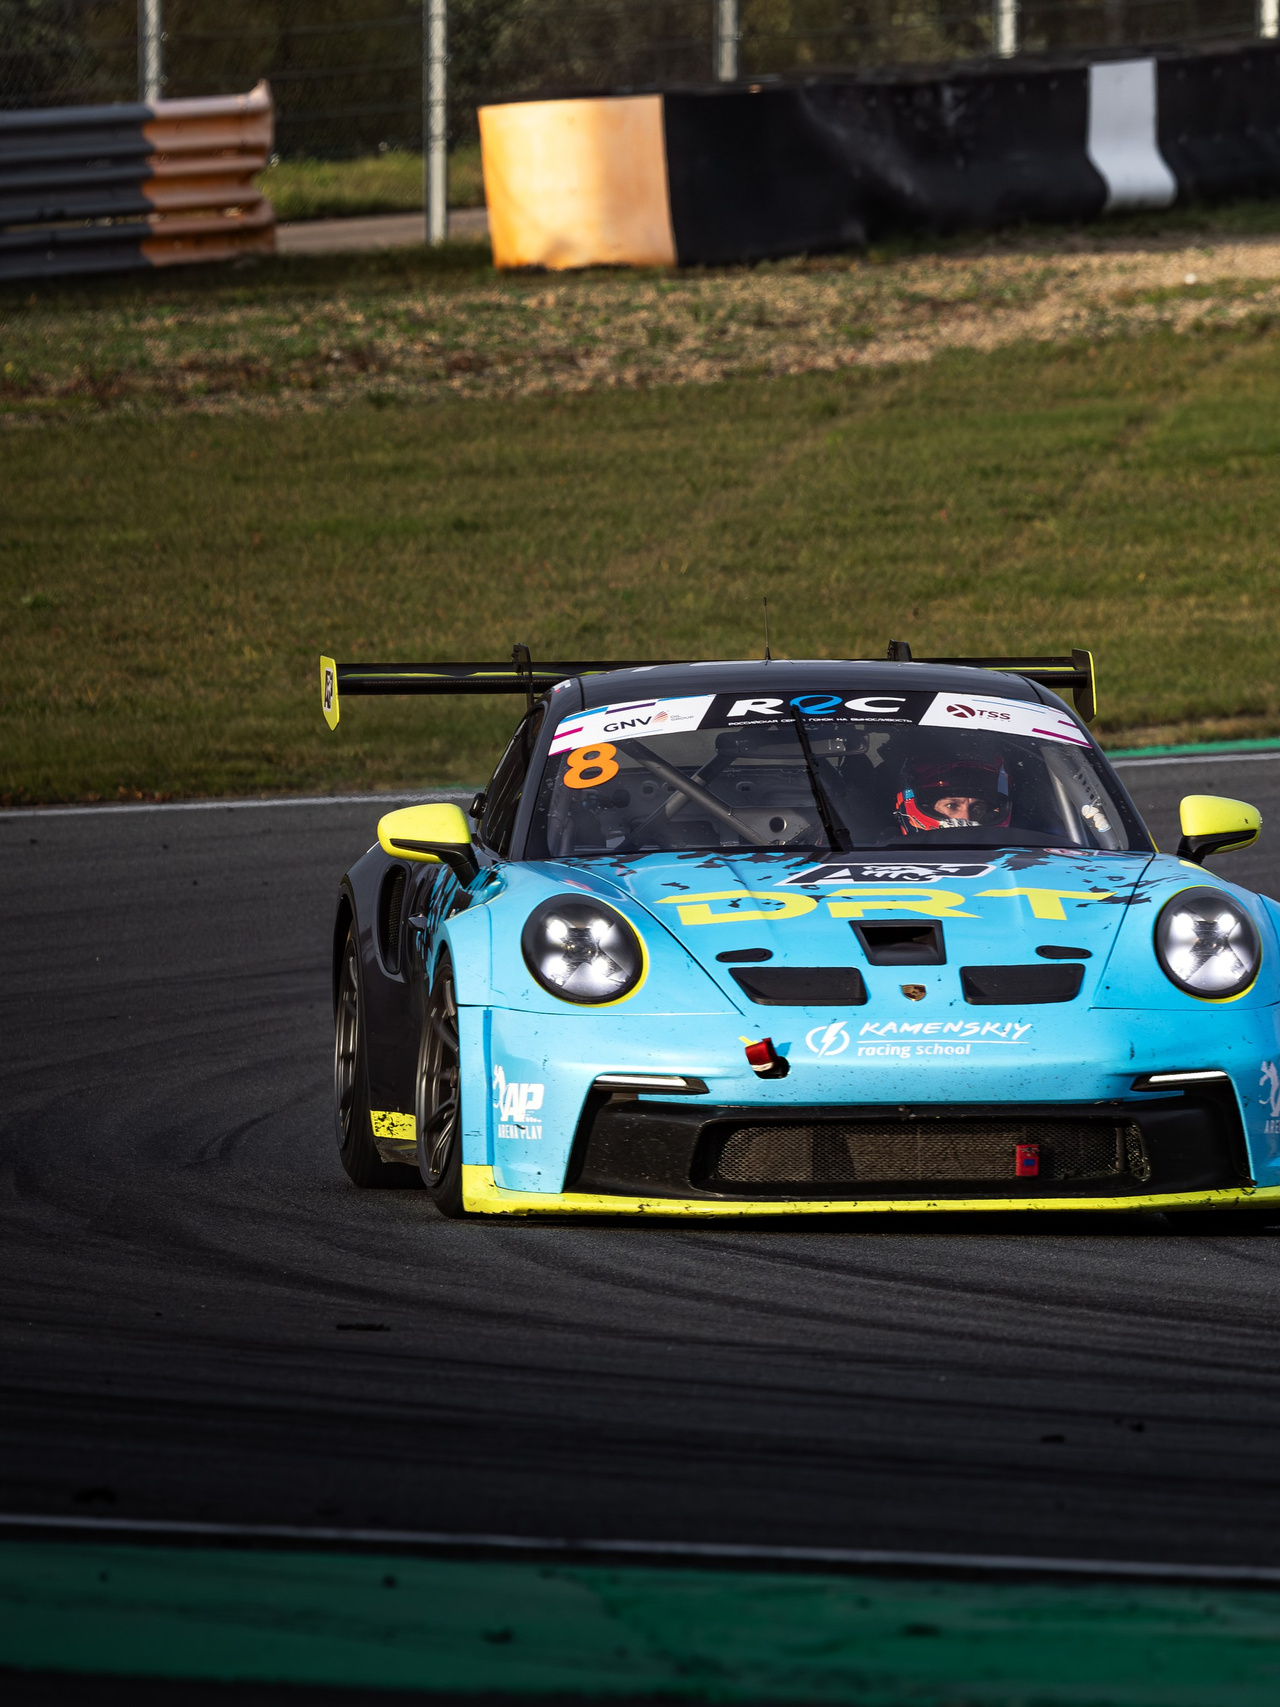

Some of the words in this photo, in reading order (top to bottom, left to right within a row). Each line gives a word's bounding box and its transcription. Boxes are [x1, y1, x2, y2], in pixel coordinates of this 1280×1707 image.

[977, 709, 1011, 720] TSS
[603, 716, 652, 732] GNV
[563, 742, 620, 789] 8
[653, 888, 1119, 926] DRT
[859, 1020, 1033, 1040] KAMENSKIY
[857, 1044, 911, 1059] racing
[915, 1043, 971, 1056] school
